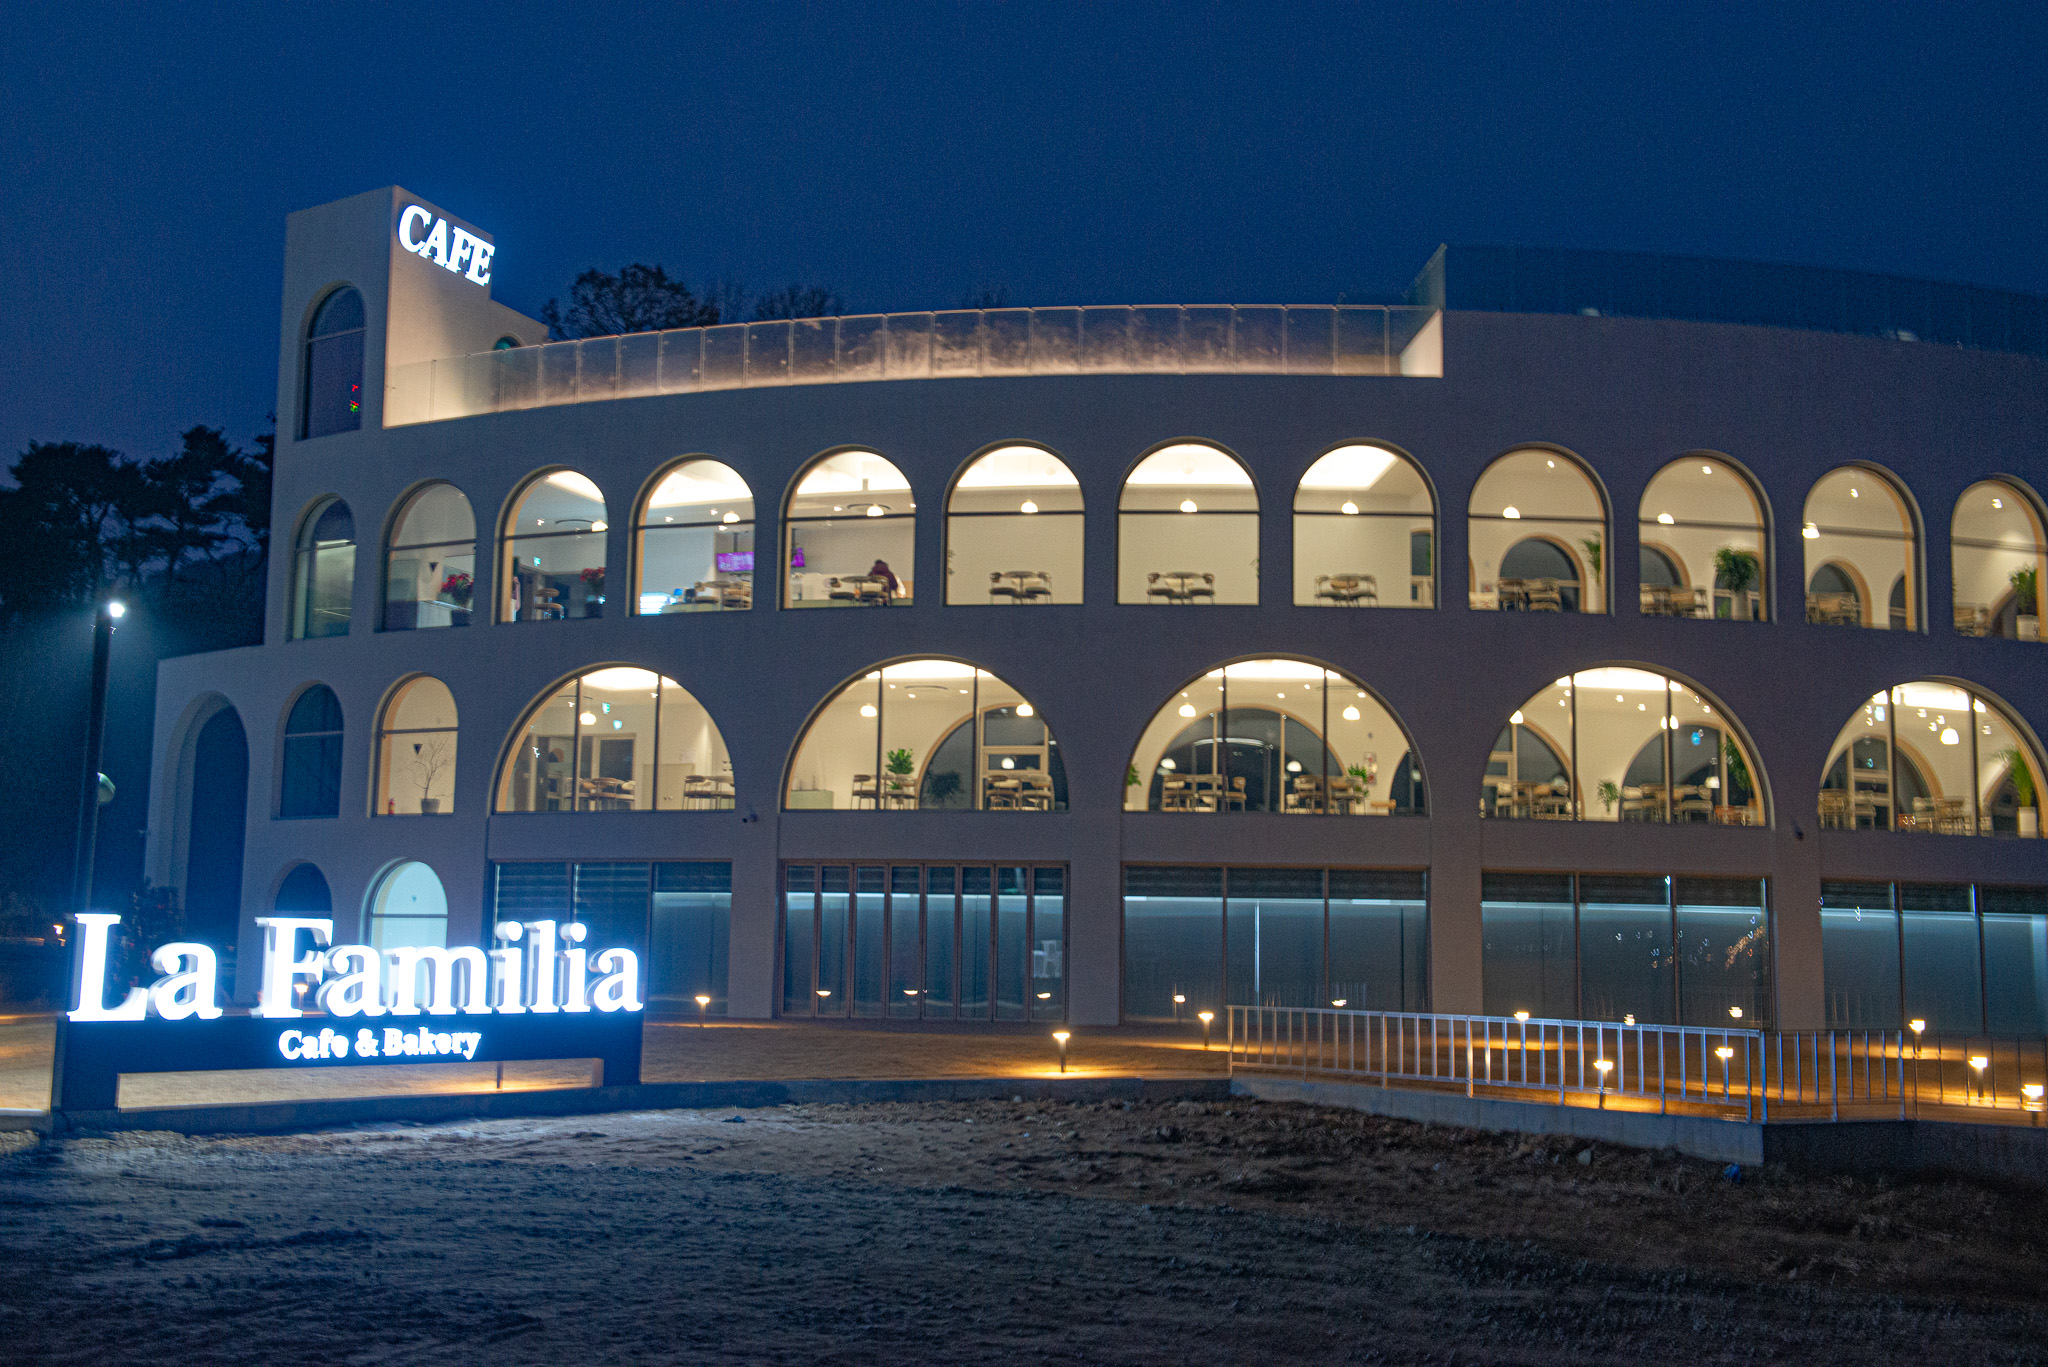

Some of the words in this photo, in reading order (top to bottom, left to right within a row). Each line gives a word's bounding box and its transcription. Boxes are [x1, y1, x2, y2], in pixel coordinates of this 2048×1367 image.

[399, 205, 495, 286] CAFE
[67, 913, 223, 1021] La
[251, 917, 643, 1018] Familia
[278, 1028, 349, 1060] Cafe
[354, 1028, 379, 1057] &
[382, 1027, 482, 1060] Bakery
